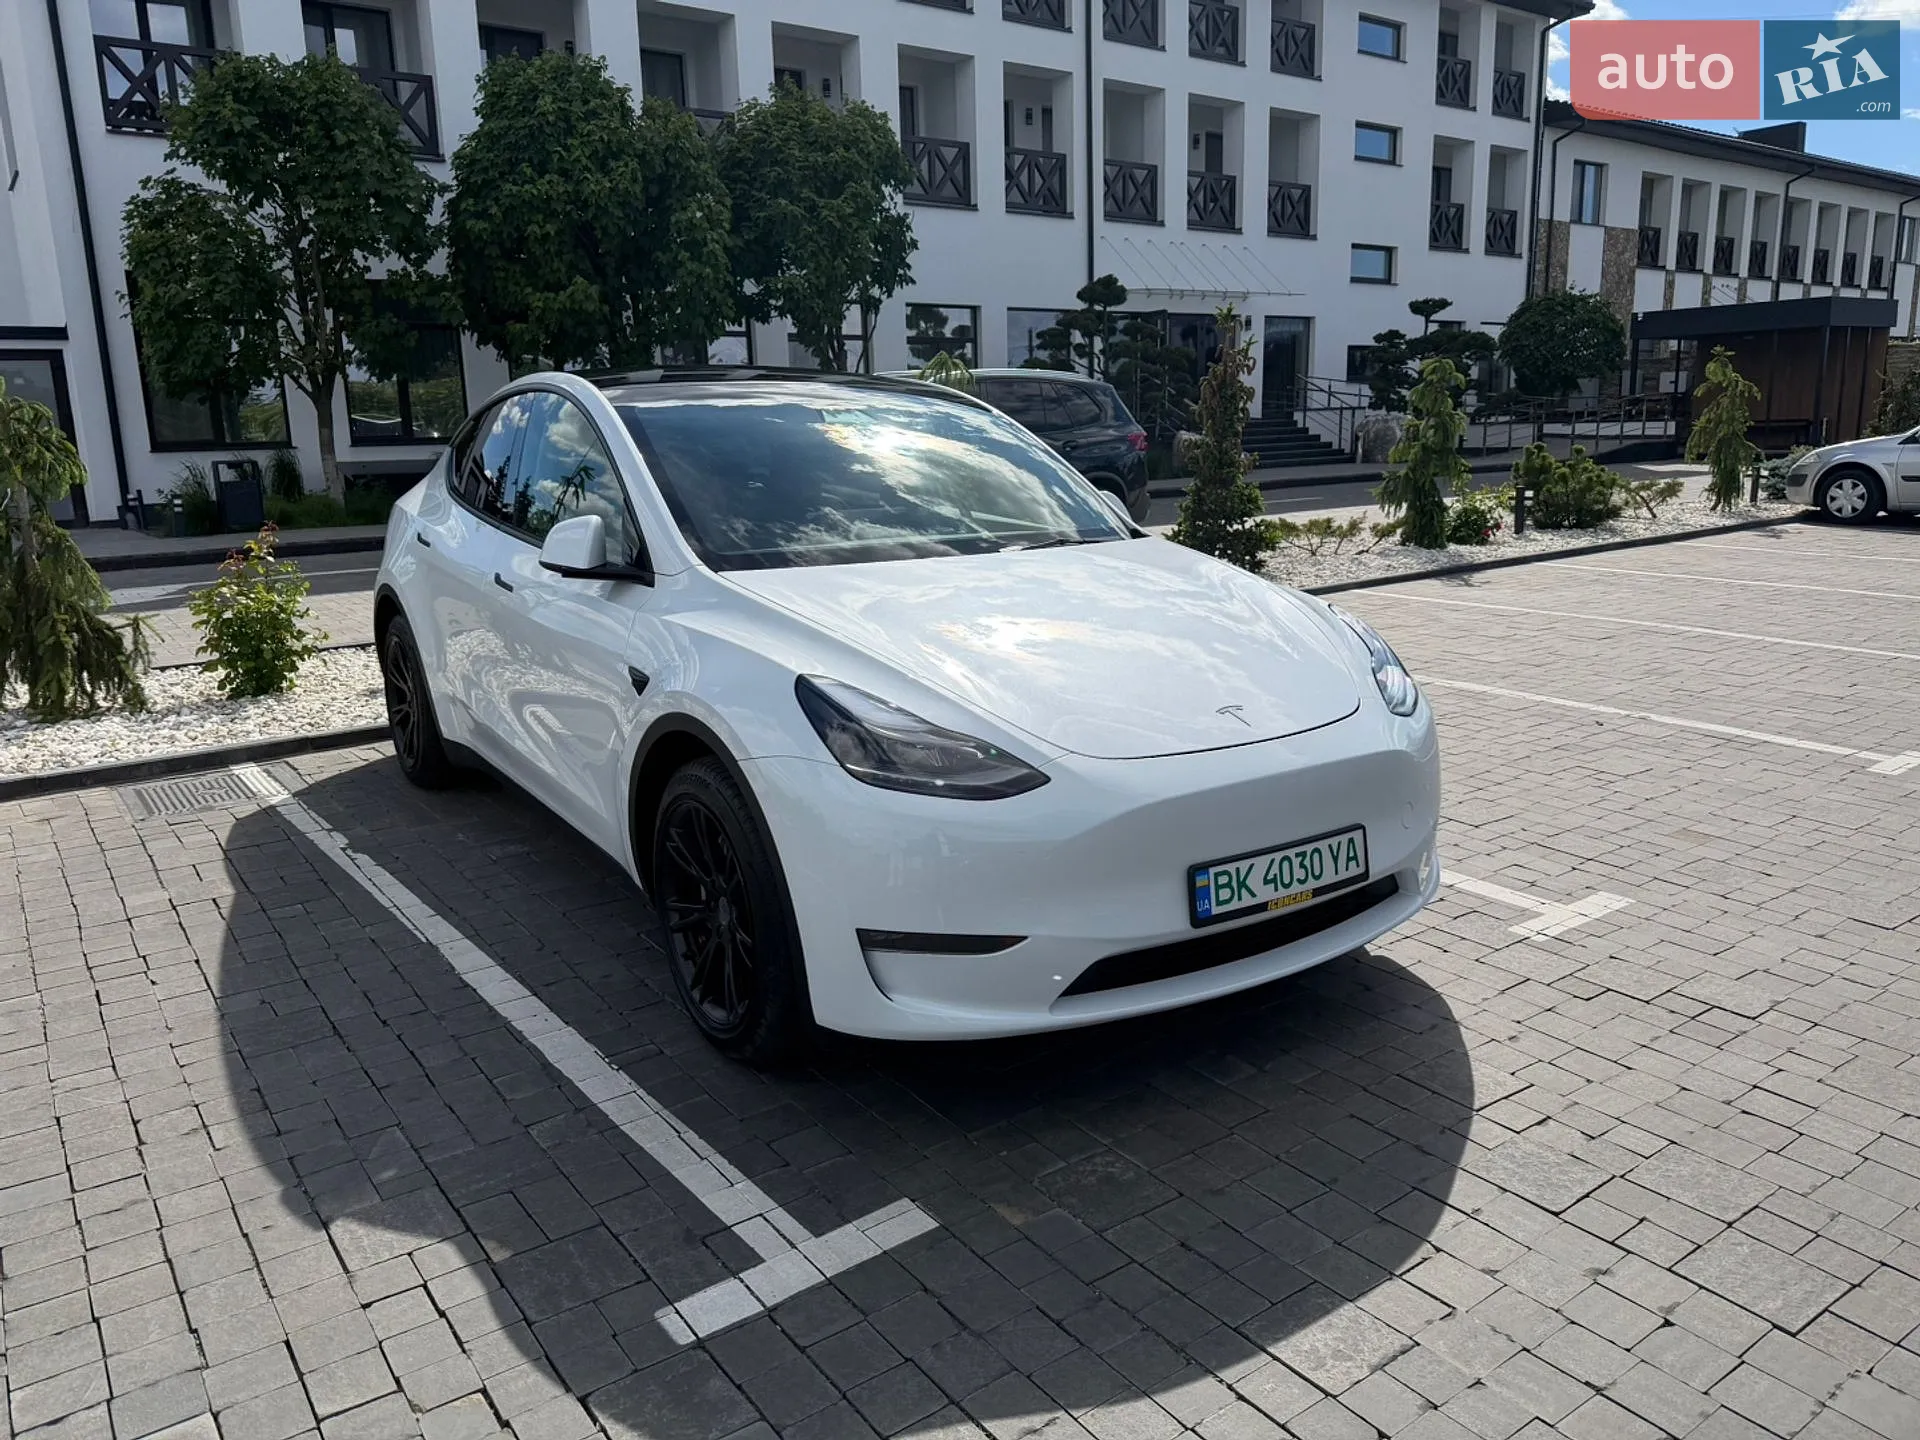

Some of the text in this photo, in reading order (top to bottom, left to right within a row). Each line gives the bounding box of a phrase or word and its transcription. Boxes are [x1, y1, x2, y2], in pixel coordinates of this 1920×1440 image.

[1213, 837, 1360, 907] BK 4030 YA
[1197, 899, 1210, 912] UA
